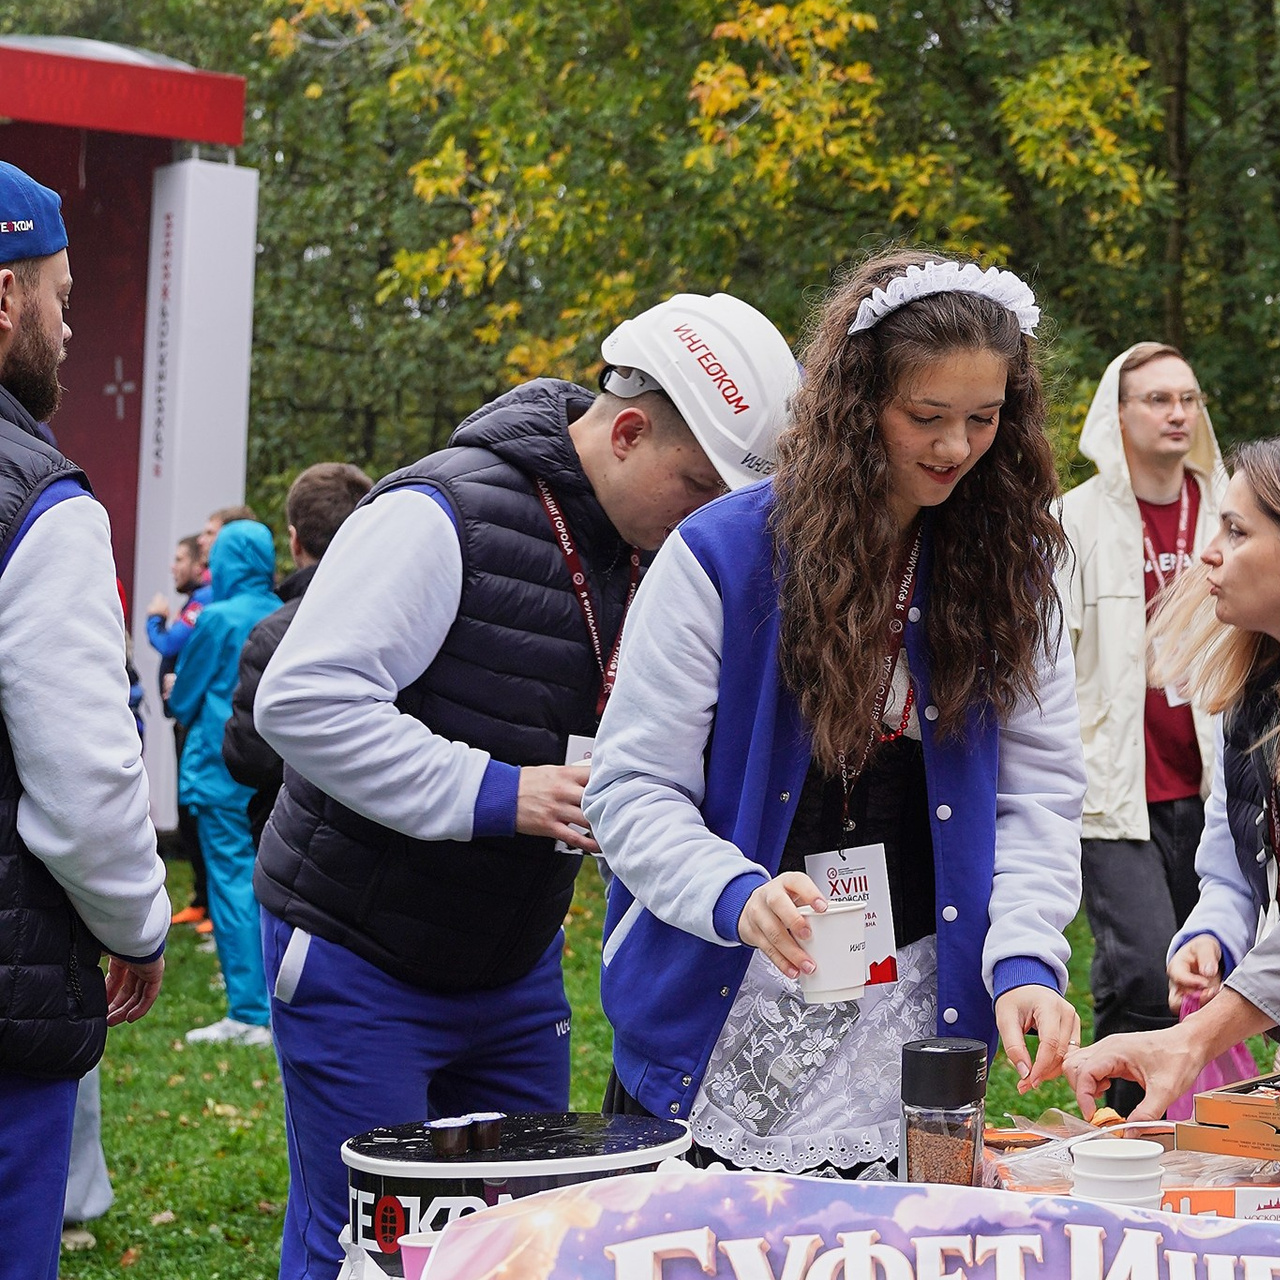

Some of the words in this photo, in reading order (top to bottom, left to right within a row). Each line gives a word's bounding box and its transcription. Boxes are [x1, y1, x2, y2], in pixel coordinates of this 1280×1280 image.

[0, 220, 34, 232] ЕОКОМ
[673, 323, 750, 415] ИНГЕОКОМ
[537, 478, 560, 516] ДАМЕНТ
[553, 516, 574, 556] ГОРОДА
[898, 539, 921, 602] ФУНДАМЕНТ
[895, 603, 905, 611] Я
[828, 875, 868, 897] XVIII
